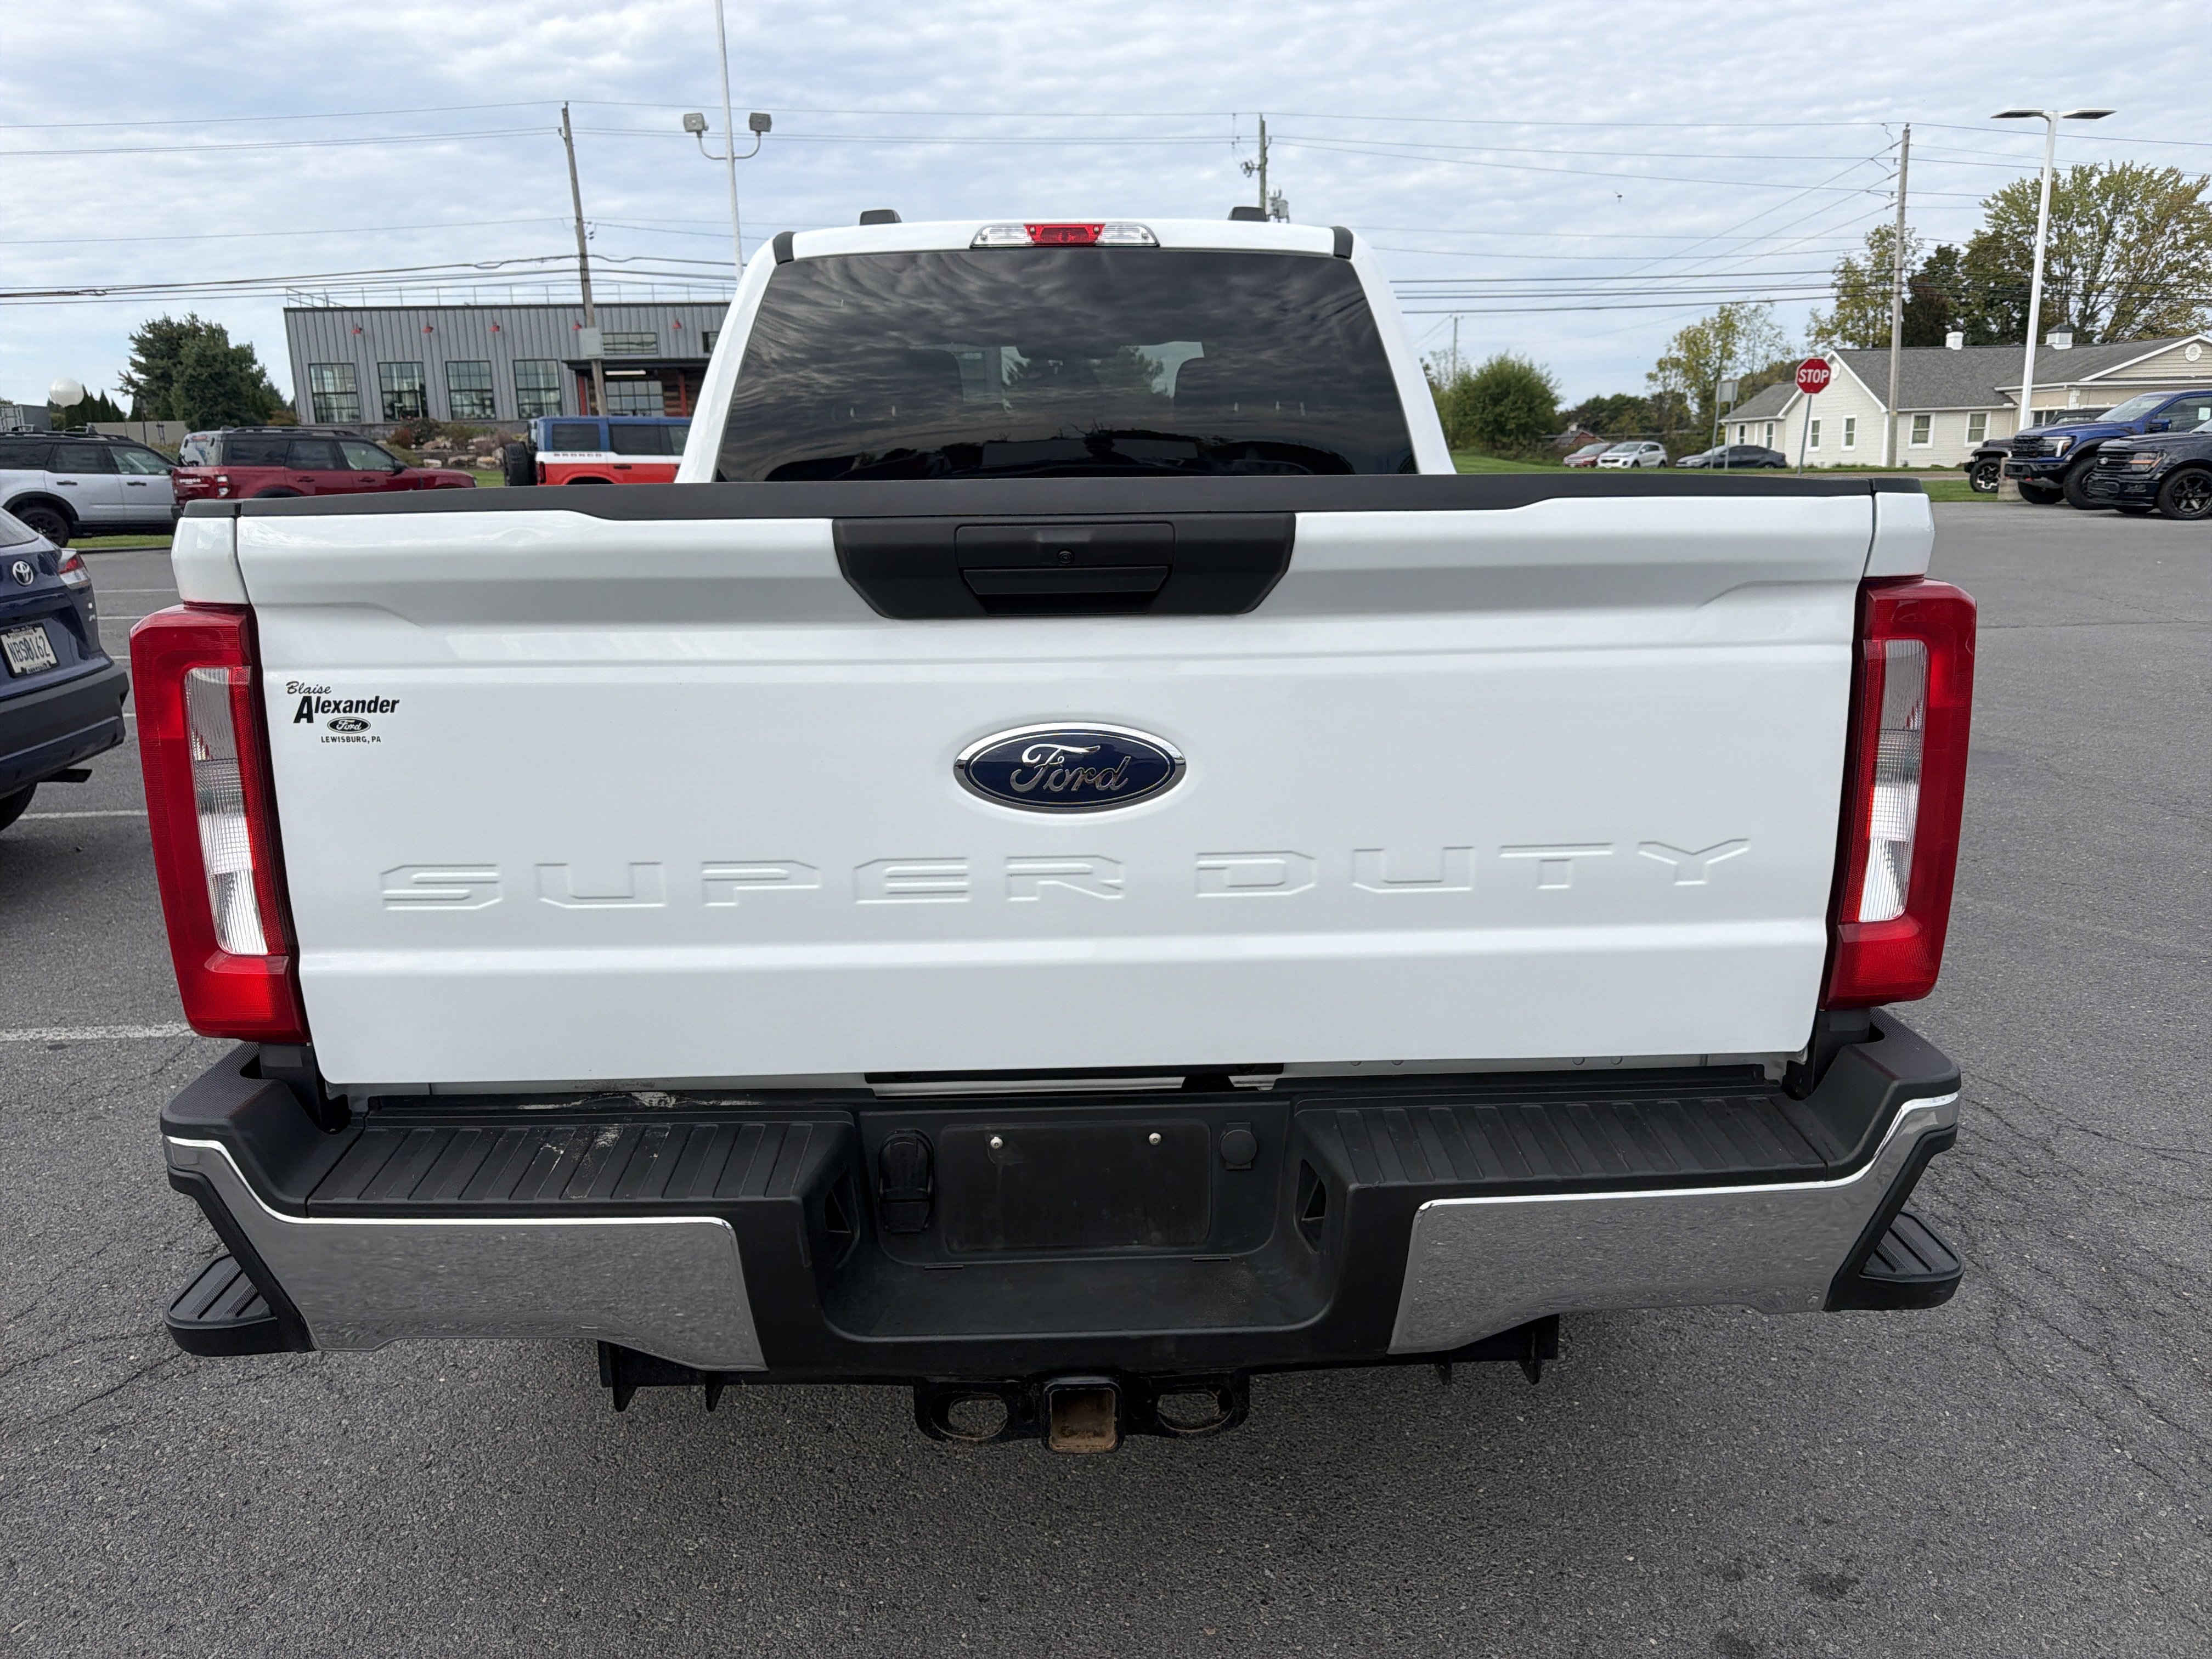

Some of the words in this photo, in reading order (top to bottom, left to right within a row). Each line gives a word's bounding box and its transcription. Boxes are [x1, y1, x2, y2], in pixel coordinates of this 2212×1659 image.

[1798, 369, 1829, 383] STOP
[286, 681, 332, 695] Blaise
[293, 696, 400, 724] Alexander
[336, 719, 362, 730] Ford
[321, 736, 370, 744] LEWISBURG,
[1009, 743, 1131, 792] Ford
[380, 854, 1126, 911] SUPER
[1195, 838, 1751, 898] DUTY
